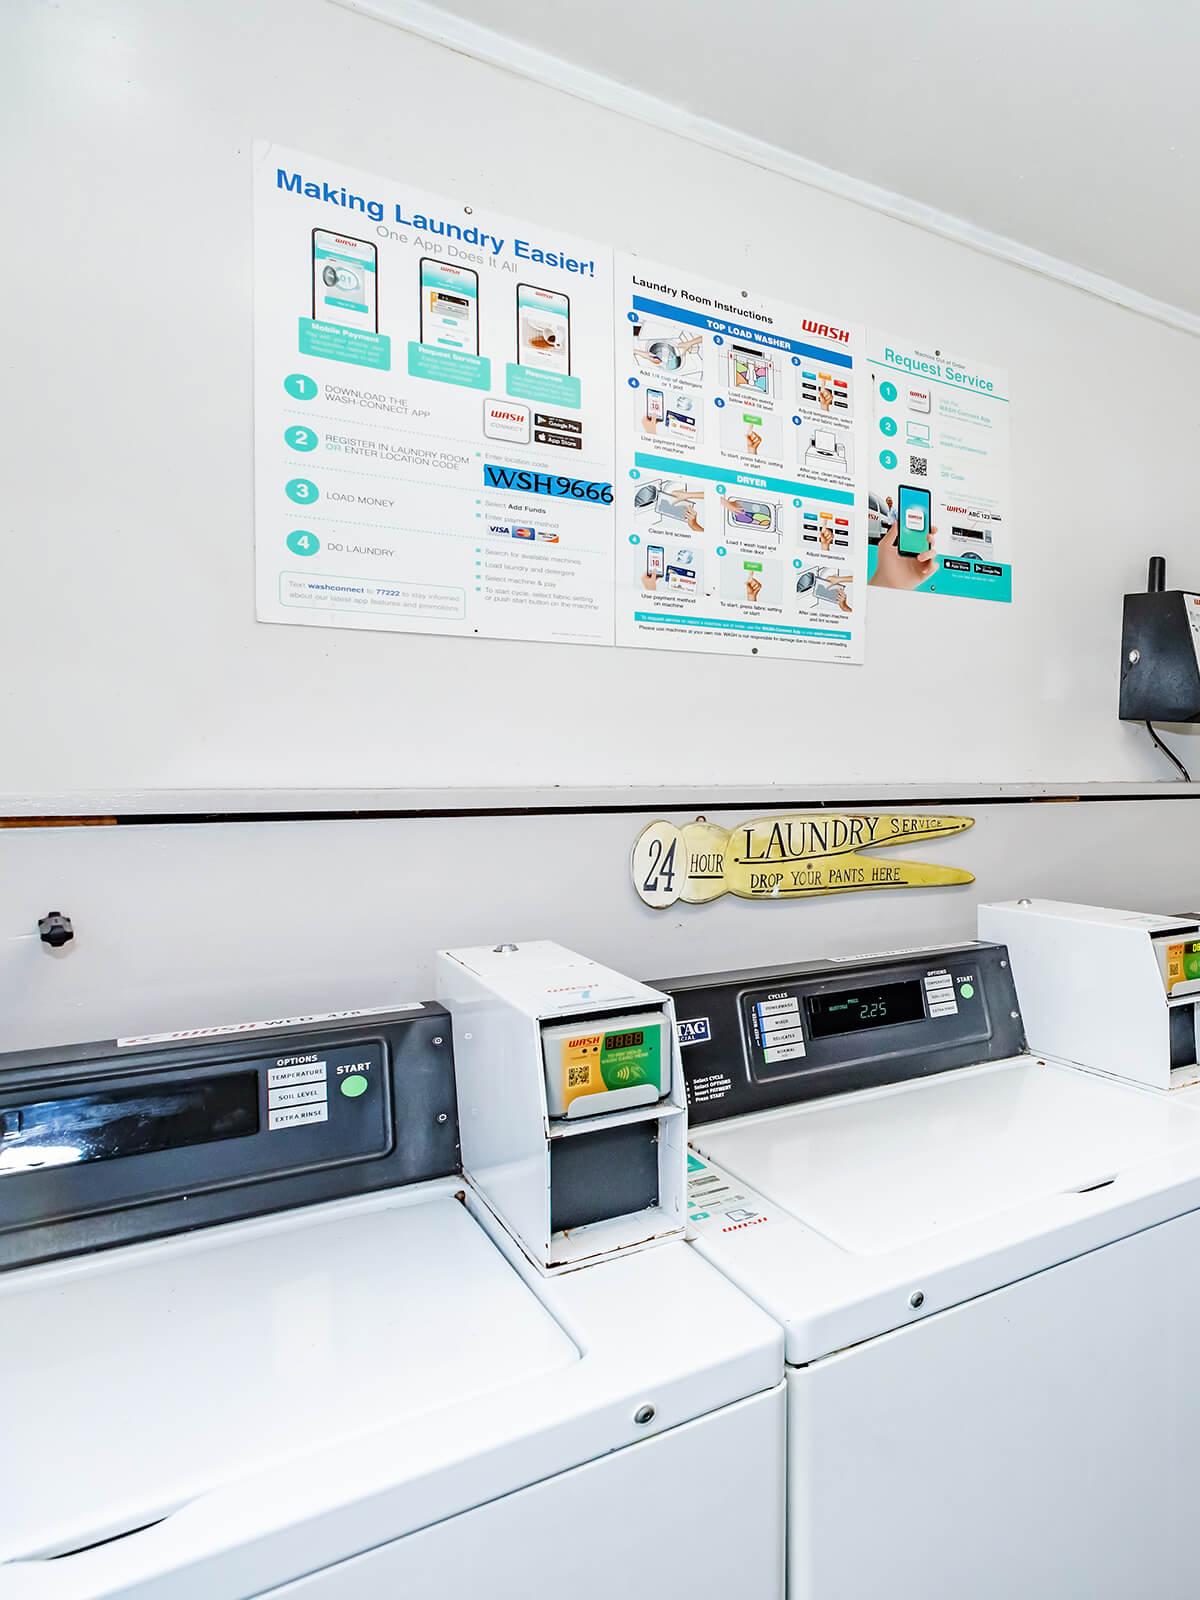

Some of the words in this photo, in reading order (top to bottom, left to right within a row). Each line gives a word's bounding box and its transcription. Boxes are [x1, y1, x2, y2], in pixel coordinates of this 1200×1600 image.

[277, 168, 384, 222] Making
[395, 204, 505, 255] Laundry
[514, 239, 595, 278] Easier!
[376, 225, 408, 243] One
[413, 236, 442, 254] App
[447, 245, 484, 265] Does
[489, 256, 497, 268] It
[501, 260, 518, 273] All
[632, 275, 677, 298] Laundry
[681, 290, 712, 306] Room
[714, 300, 773, 324] Instructions
[706, 320, 726, 331] TOP
[728, 325, 752, 339] LOAD
[753, 332, 791, 350] WASHER
[802, 319, 849, 343] WASH
[885, 347, 941, 376] Request
[945, 367, 993, 391] Service
[296, 379, 305, 394] 1
[325, 384, 386, 402] DOWNLOAD
[389, 397, 408, 407] THE
[411, 409, 431, 418] APP
[491, 410, 524, 423] WASH
[295, 430, 308, 445] 2
[325, 434, 375, 449] REGISTER
[378, 443, 388, 451] IN
[391, 445, 437, 460] LAUNDRY
[440, 453, 470, 464] ROOM
[325, 443, 342, 452] OR
[344, 447, 378, 458] ENTER
[380, 451, 429, 466] LOCATION
[431, 460, 459, 471] CODE
[488, 467, 552, 495] WSH
[556, 476, 614, 503] 9666
[736, 474, 767, 488] DRYER
[296, 483, 309, 498] 3
[326, 491, 355, 503] LOAD
[358, 496, 395, 508] MONEY
[524, 505, 546, 514] Funds
[489, 526, 510, 534] VISA
[297, 535, 310, 550] 4
[327, 543, 343, 552] DO
[346, 545, 395, 557] LAUNDRY
[308, 582, 364, 594] washconnect
[376, 589, 400, 597] 77222
[743, 816, 879, 860] LAUNDRY
[890, 818, 942, 834] SERVICE
[643, 837, 677, 892] 24
[690, 853, 723, 874] HOUR
[749, 872, 783, 889] DROP
[791, 869, 822, 886] YOUR
[828, 868, 864, 884] PANTS
[871, 866, 900, 882] HERE
[956, 975, 973, 983] START
[768, 992, 788, 1000] CYCLES
[860, 1002, 887, 1019] 2.25
[568, 1036, 600, 1048] WASH
[277, 1054, 318, 1067] OPTIONS
[271, 1068, 323, 1081] TEMPERATURE
[336, 1062, 371, 1075] START
[278, 1094, 294, 1102] SOIL
[297, 1090, 318, 1099] LEVEL
[275, 1113, 299, 1122] EXTRA
[301, 1110, 321, 1118] RINSE
